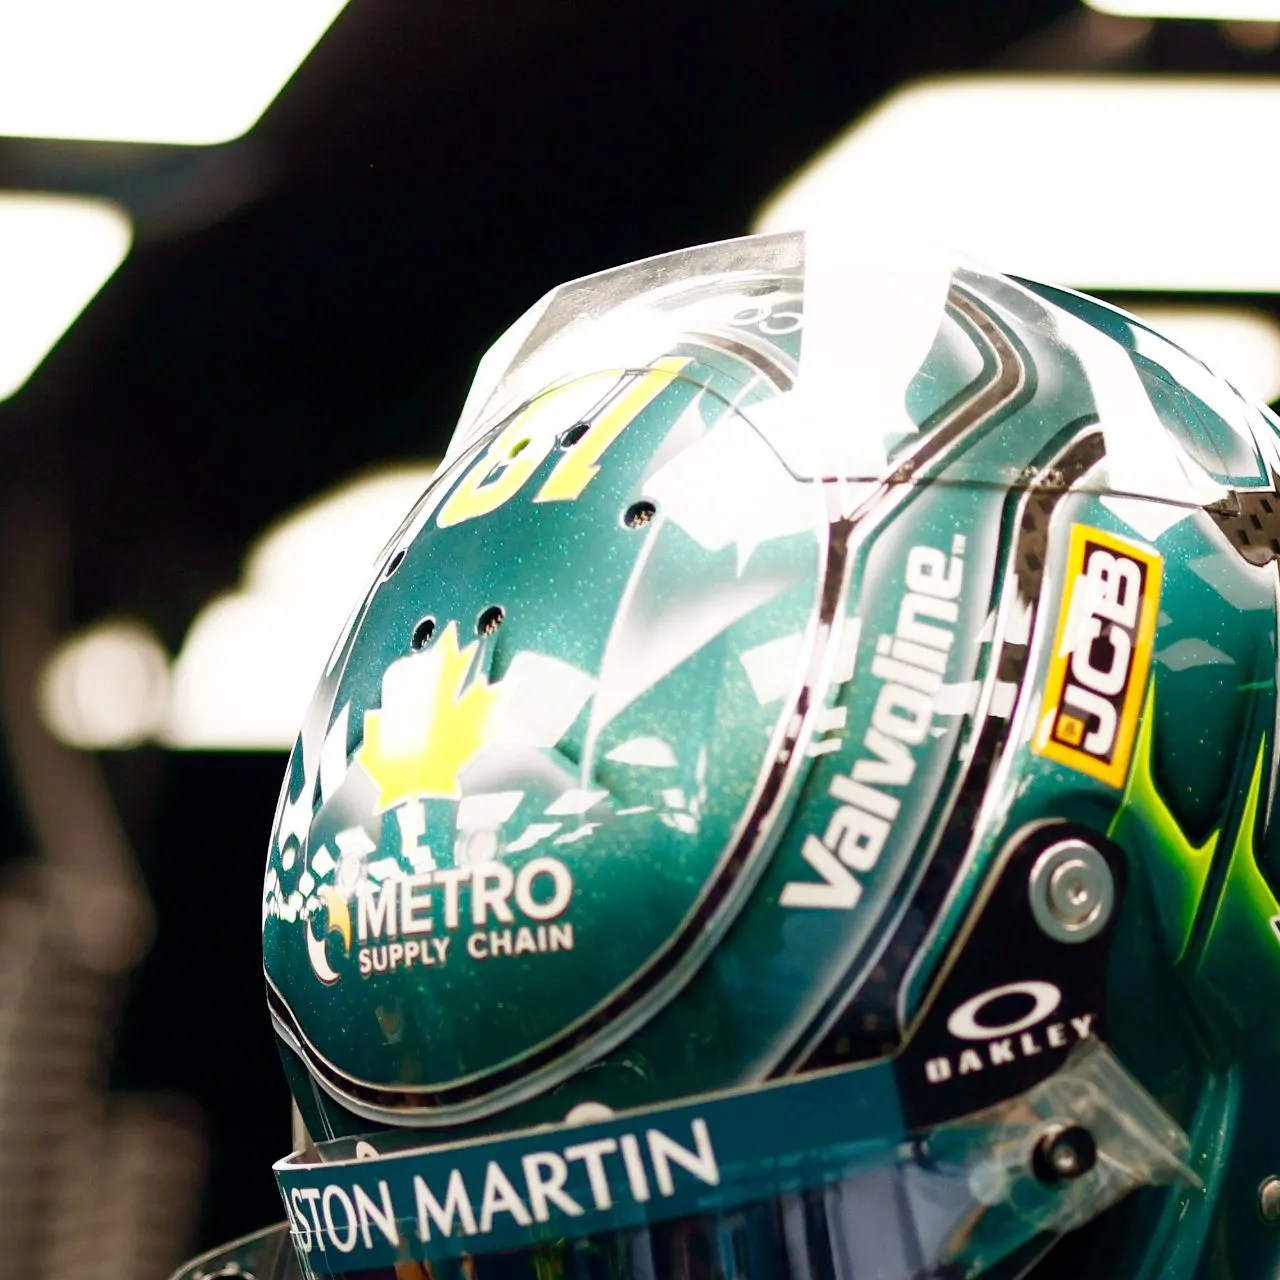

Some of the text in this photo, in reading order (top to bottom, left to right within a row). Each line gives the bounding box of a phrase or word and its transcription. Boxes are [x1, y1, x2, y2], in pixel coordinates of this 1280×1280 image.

[1064, 549, 1142, 756] JCB
[780, 545, 963, 910] Valvoline
[356, 856, 573, 944] METRO
[358, 922, 574, 979] SUPPLY CHAIN
[925, 1013, 1094, 1083] OAKLEY
[413, 1117, 719, 1243] MARTIN
